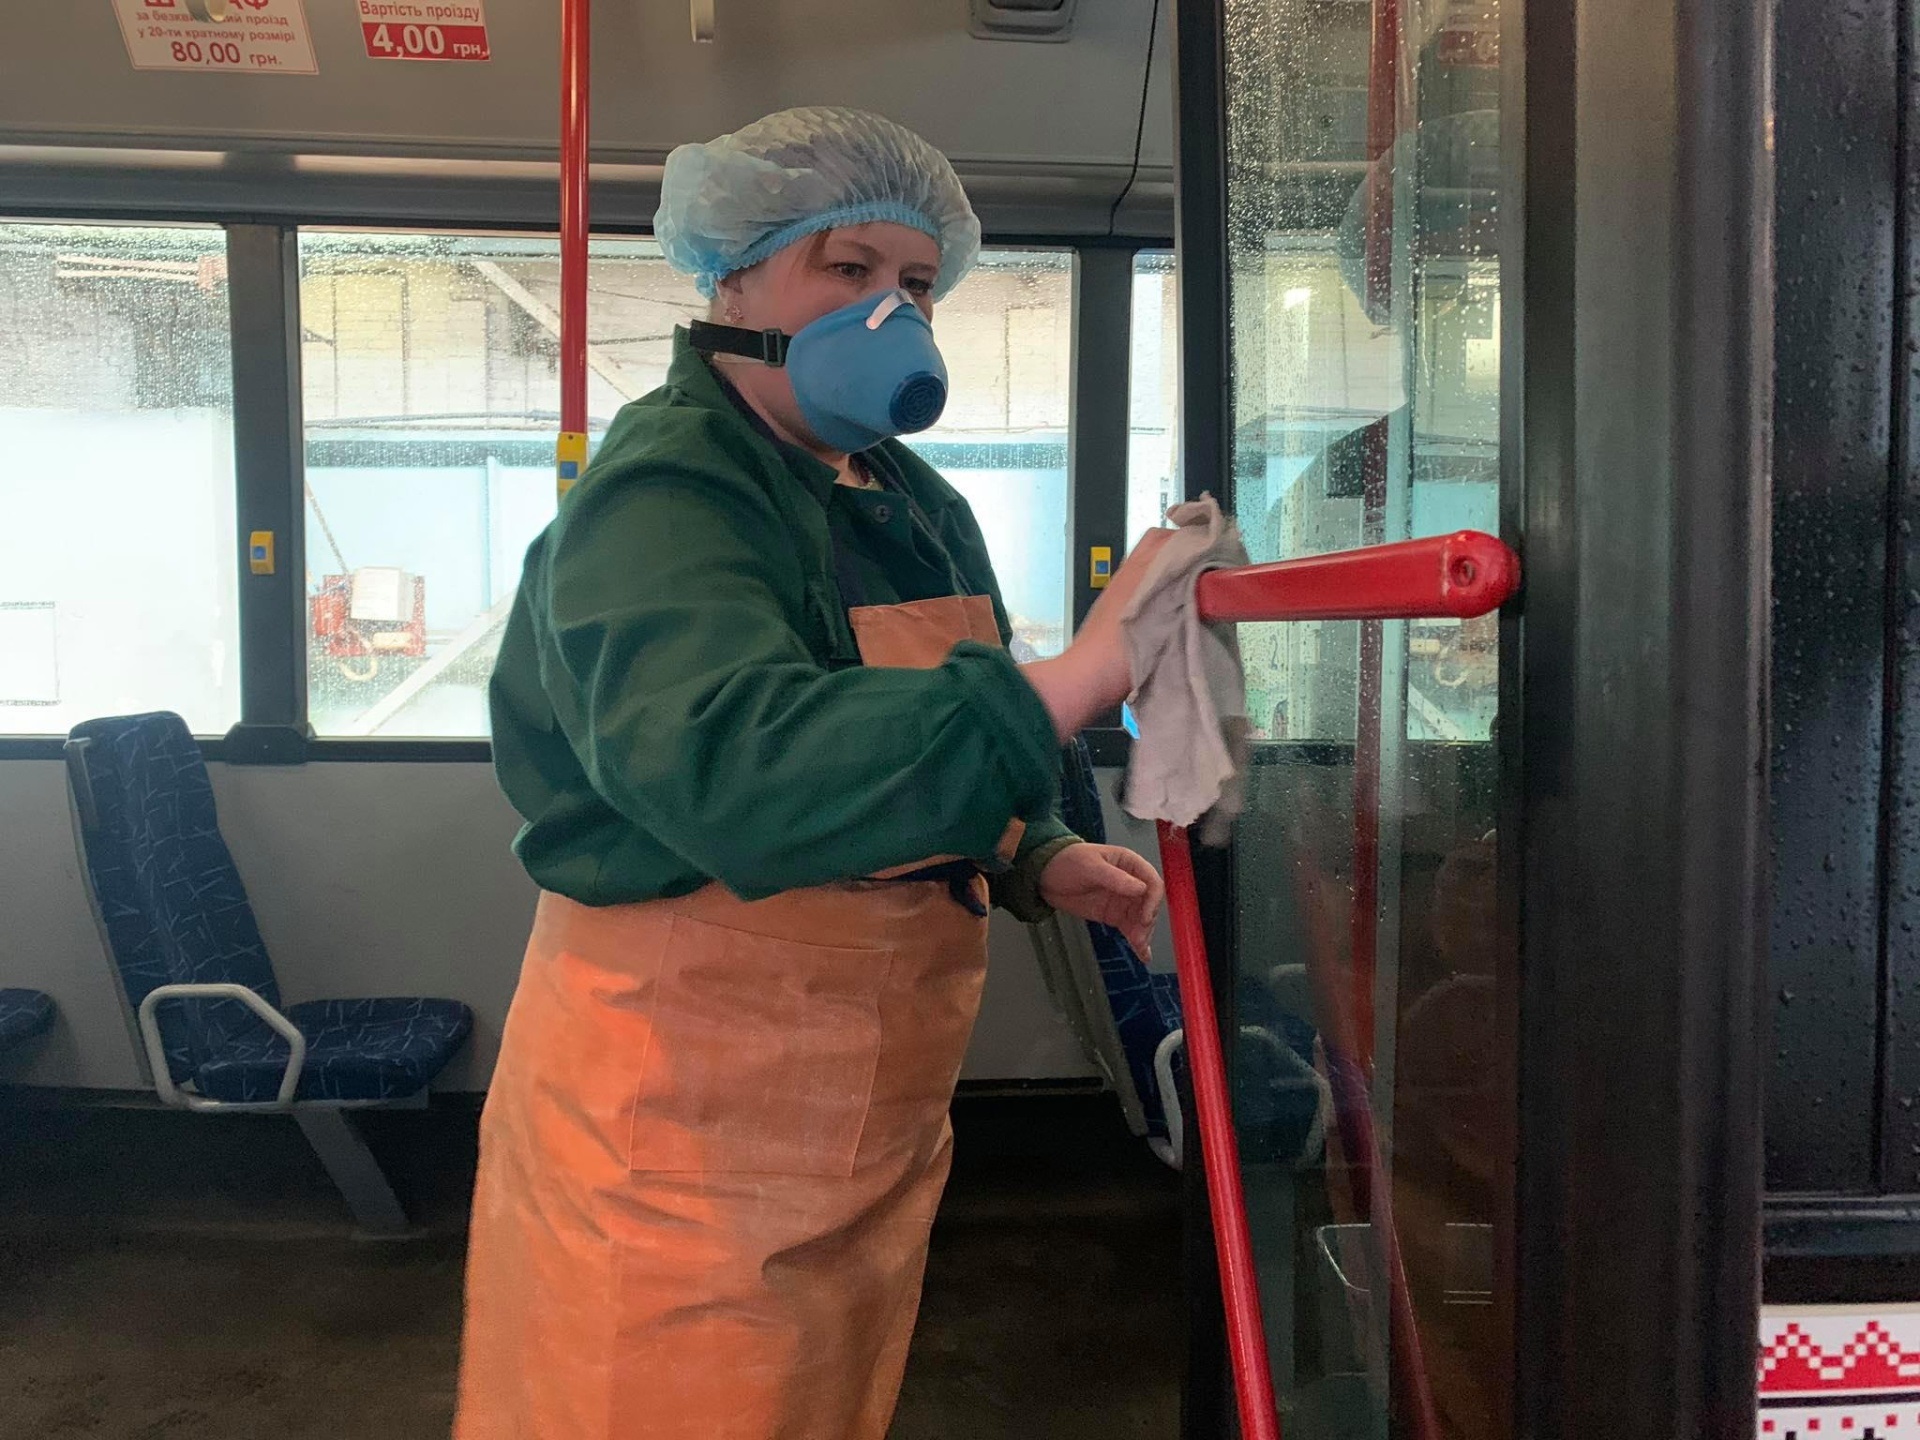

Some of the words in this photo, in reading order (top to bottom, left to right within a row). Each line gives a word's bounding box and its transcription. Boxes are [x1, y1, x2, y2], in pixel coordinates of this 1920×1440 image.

[136, 12, 150, 21] за
[360, 1, 422, 19] Вартість
[426, 3, 480, 22] проїзду
[137, 28, 145, 38] у
[148, 26, 182, 37] 20-ти
[185, 29, 245, 42] кратному
[249, 30, 295, 42] розмірі
[372, 23, 445, 58] 4,00
[453, 43, 487, 57] грн.
[171, 41, 241, 65] 80,00
[249, 53, 283, 67] грн.
